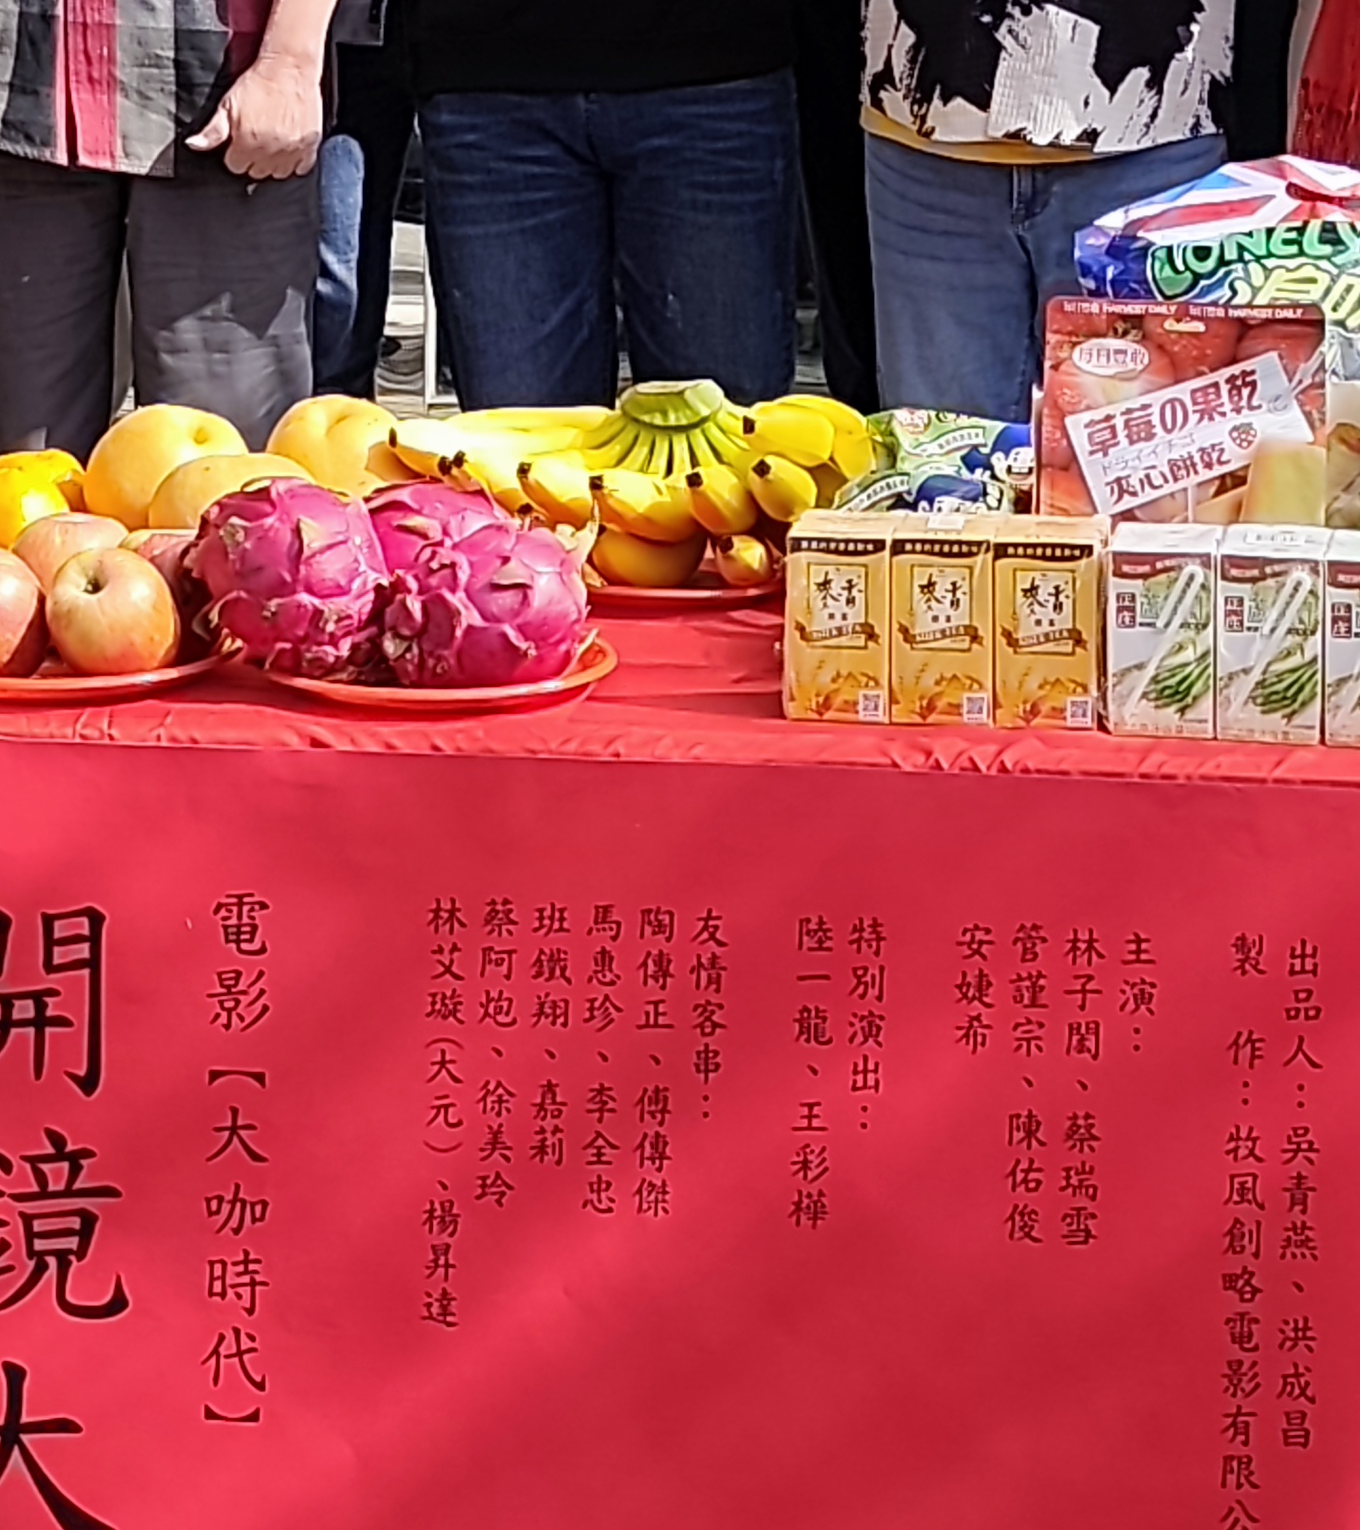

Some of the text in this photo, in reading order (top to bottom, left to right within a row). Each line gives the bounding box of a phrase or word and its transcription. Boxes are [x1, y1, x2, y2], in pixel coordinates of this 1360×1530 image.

[1083, 368, 1263, 459] 草莓の果乾
[1147, 304, 1178, 316] DAILY
[1275, 308, 1304, 319] DAILY
[1104, 442, 1232, 506] 夾心餅乾
[474, 896, 520, 1210] 蔡阿炮、徐美玲
[527, 901, 573, 1169] 班鐵翔、嘉莉
[580, 903, 623, 1217] 馬惠珍、李全忠
[689, 907, 728, 1122] 友情客串：
[788, 915, 834, 1232] 陸一龍、王彩樺
[846, 916, 887, 1131] 特別演出：
[954, 923, 996, 1056] 安婕希
[1118, 932, 1158, 1055] 主演：
[200, 891, 271, 1424] 電影【大咖時代】
